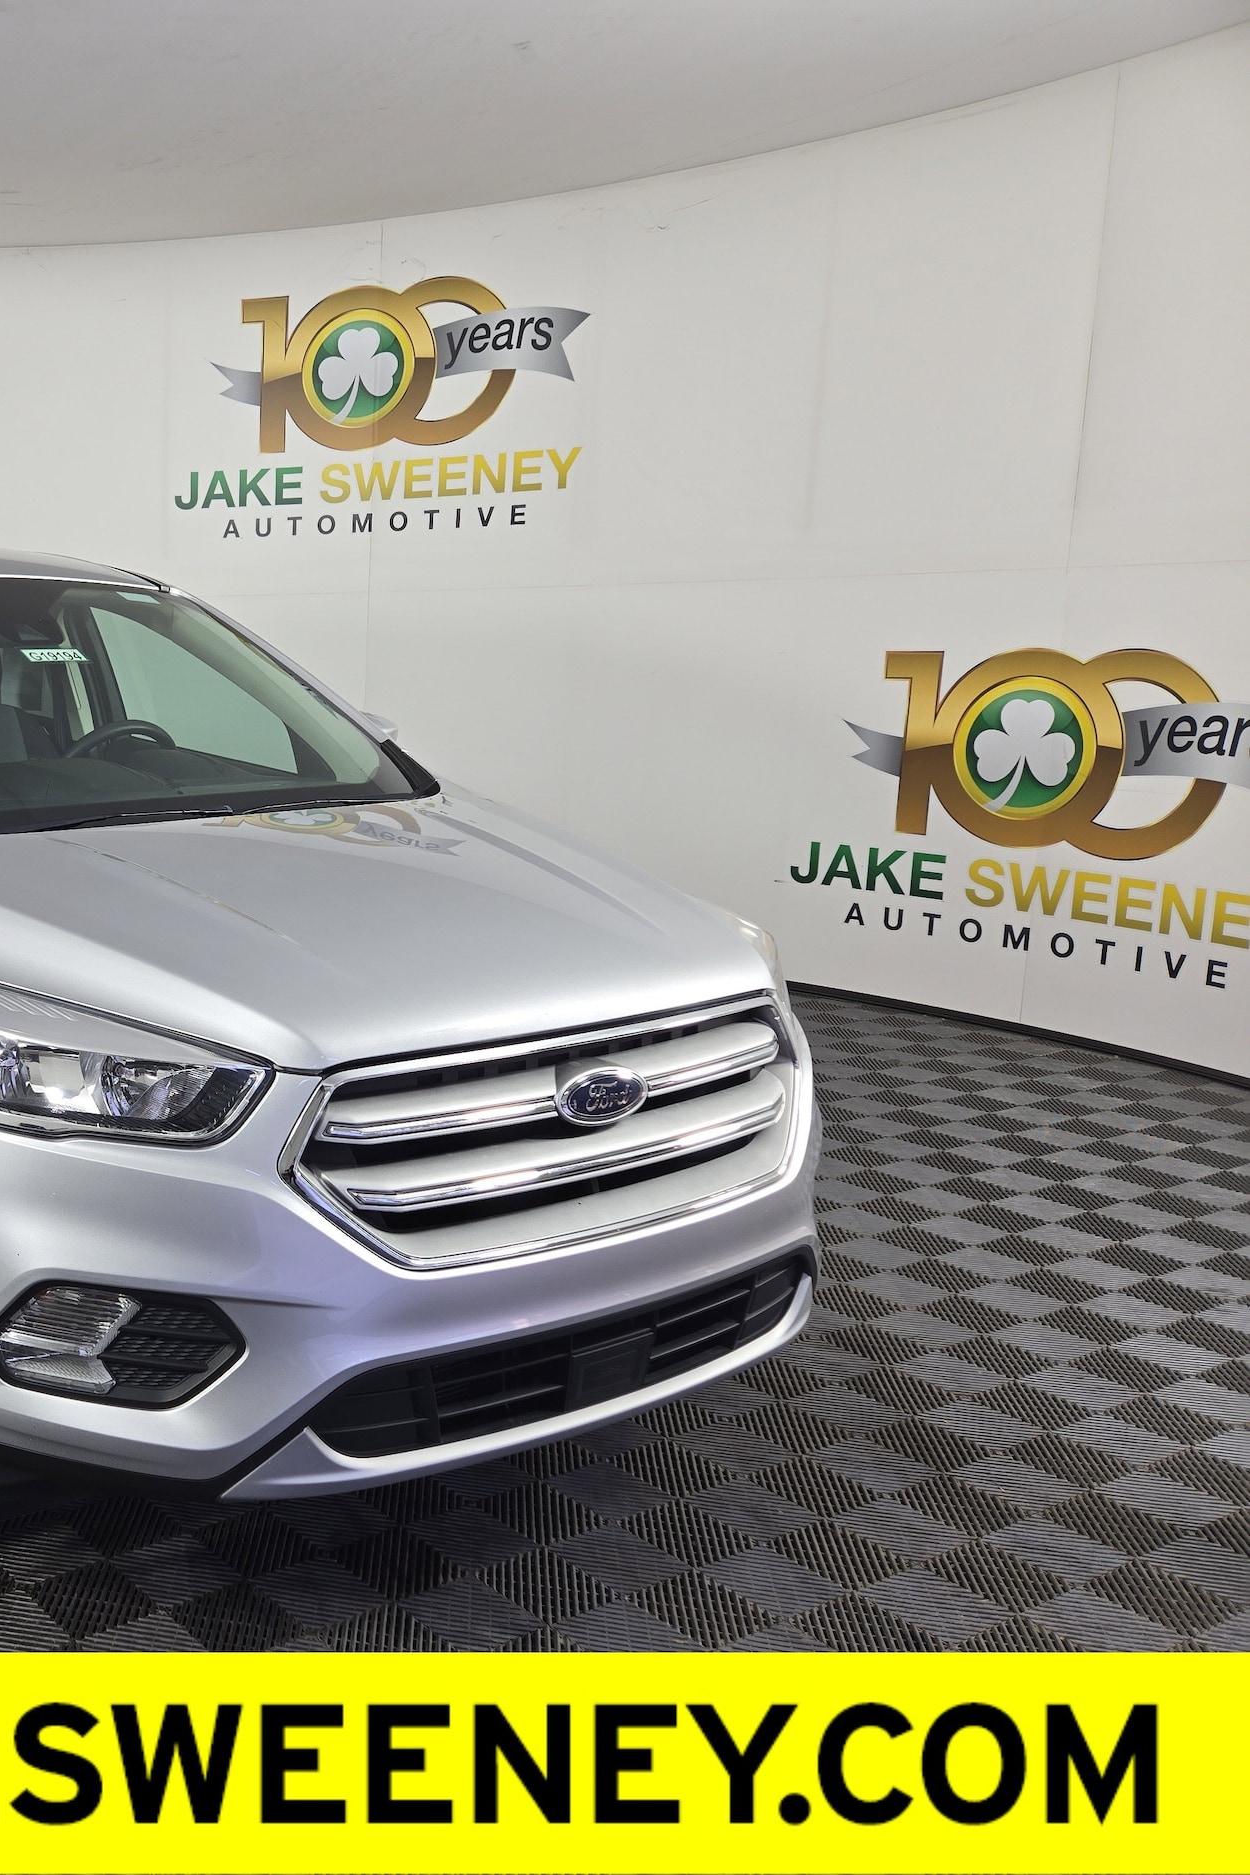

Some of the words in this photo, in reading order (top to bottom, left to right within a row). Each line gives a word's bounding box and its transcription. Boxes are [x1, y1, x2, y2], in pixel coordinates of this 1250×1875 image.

[444, 315, 554, 371] years
[174, 464, 304, 511] JAKE
[319, 446, 583, 505] SWEENEY
[223, 503, 528, 540] AUTOMOTIVE
[29, 651, 83, 661] G19194
[1133, 714, 1250, 768] year
[789, 841, 948, 901] JAKE
[964, 859, 1250, 950] SWEENE
[844, 903, 1229, 989] AUTOMOTIVE
[586, 1081, 632, 1112] Ford
